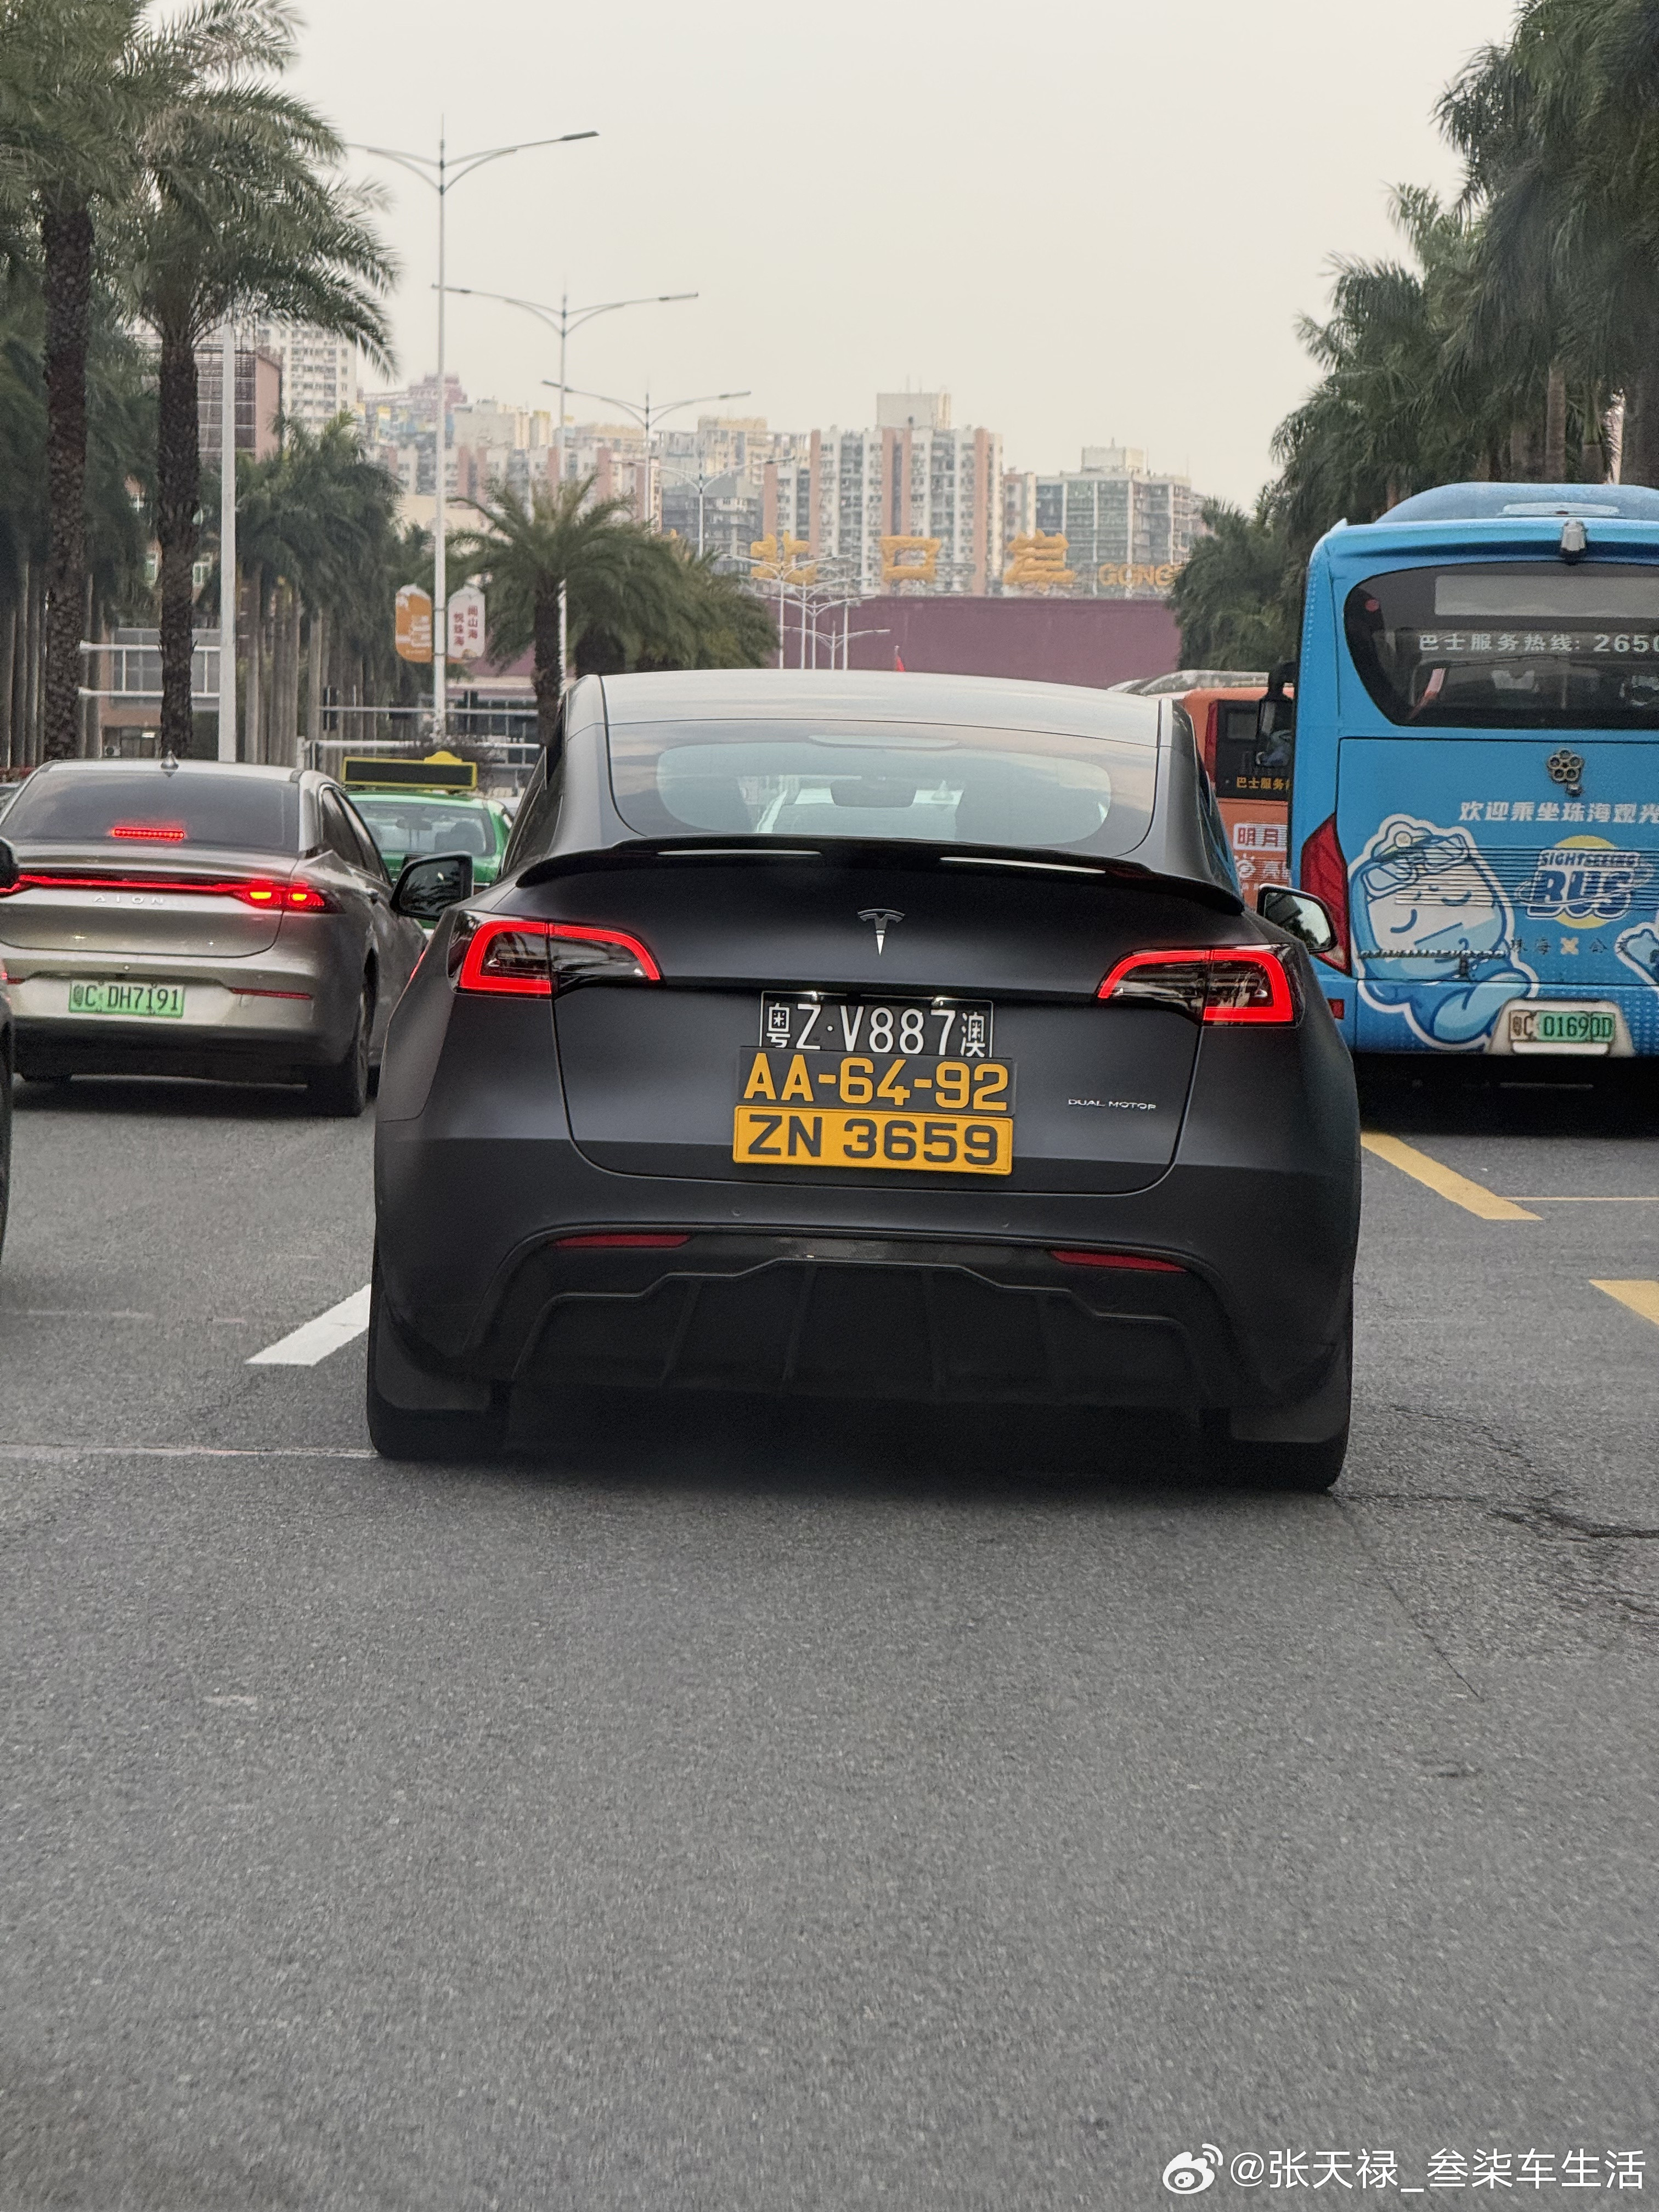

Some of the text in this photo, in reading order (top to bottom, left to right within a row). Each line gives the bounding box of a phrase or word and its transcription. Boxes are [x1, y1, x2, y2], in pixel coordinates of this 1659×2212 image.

[1098, 562, 1184, 586] GONG
[1237, 827, 1279, 847] 明月
[92, 894, 165, 905] AION
[1528, 869, 1636, 918] BUS
[107, 985, 179, 1011] DH7191
[743, 1052, 1009, 1111] AA-64-92
[1068, 1098, 1106, 1107] DUAL
[747, 1114, 998, 1166] ZN 3659
